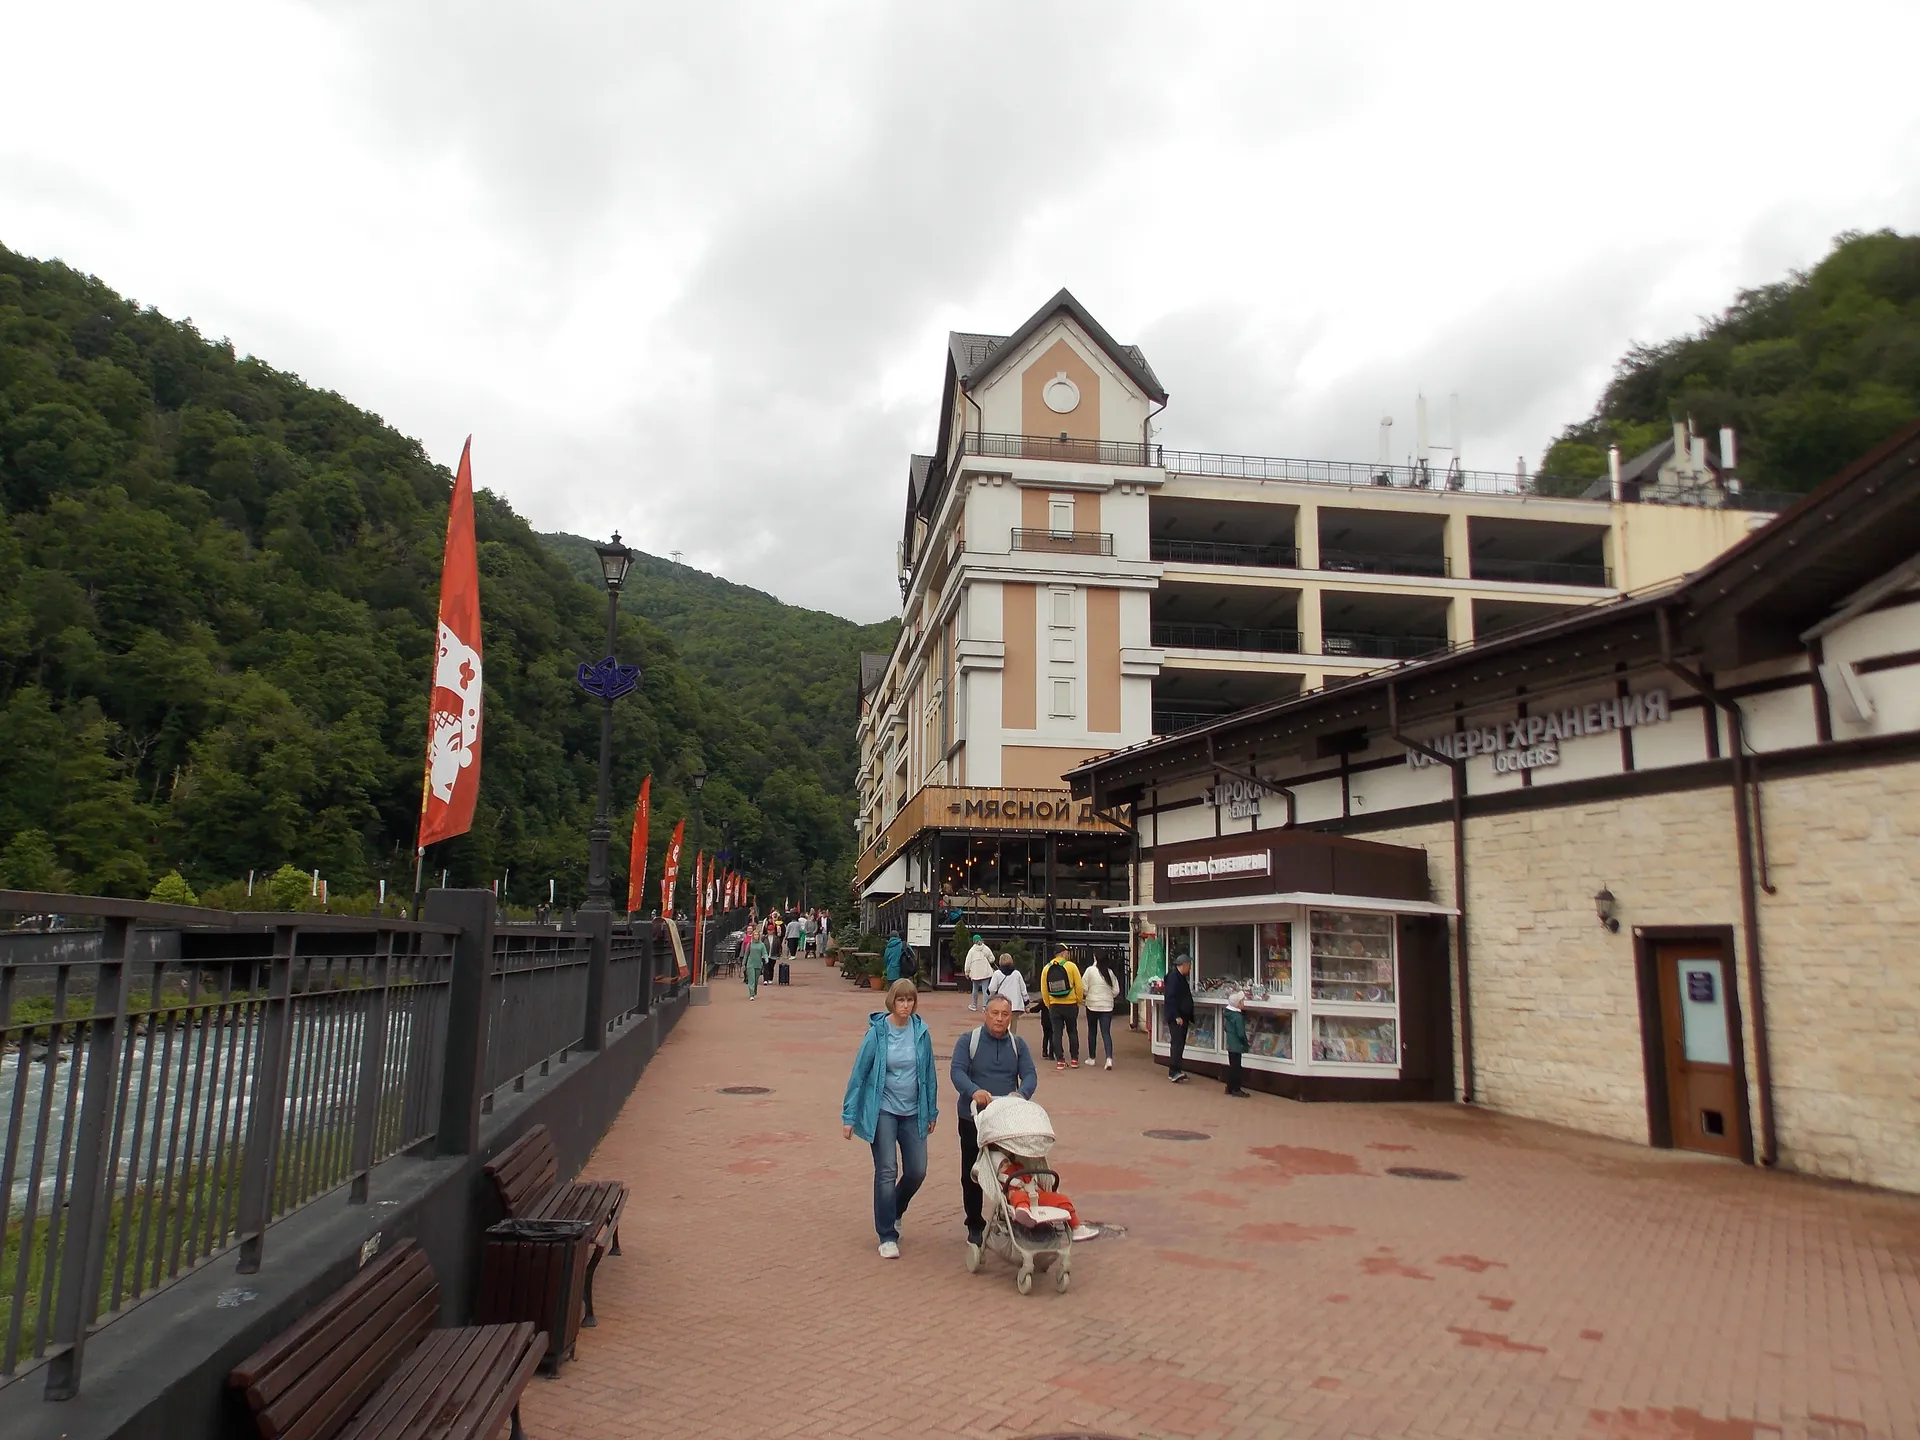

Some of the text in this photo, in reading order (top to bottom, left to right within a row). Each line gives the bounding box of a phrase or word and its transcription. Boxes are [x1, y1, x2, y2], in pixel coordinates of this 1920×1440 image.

[1508, 690, 1669, 747] ХРАНЕНИЯ
[1490, 744, 1559, 774] LOCKERS
[965, 798, 1070, 821] МЯСНОЙ
[1228, 802, 1261, 818] RENTAL
[1168, 854, 1267, 877] ПРЕССА СУВЕНИРЫ
